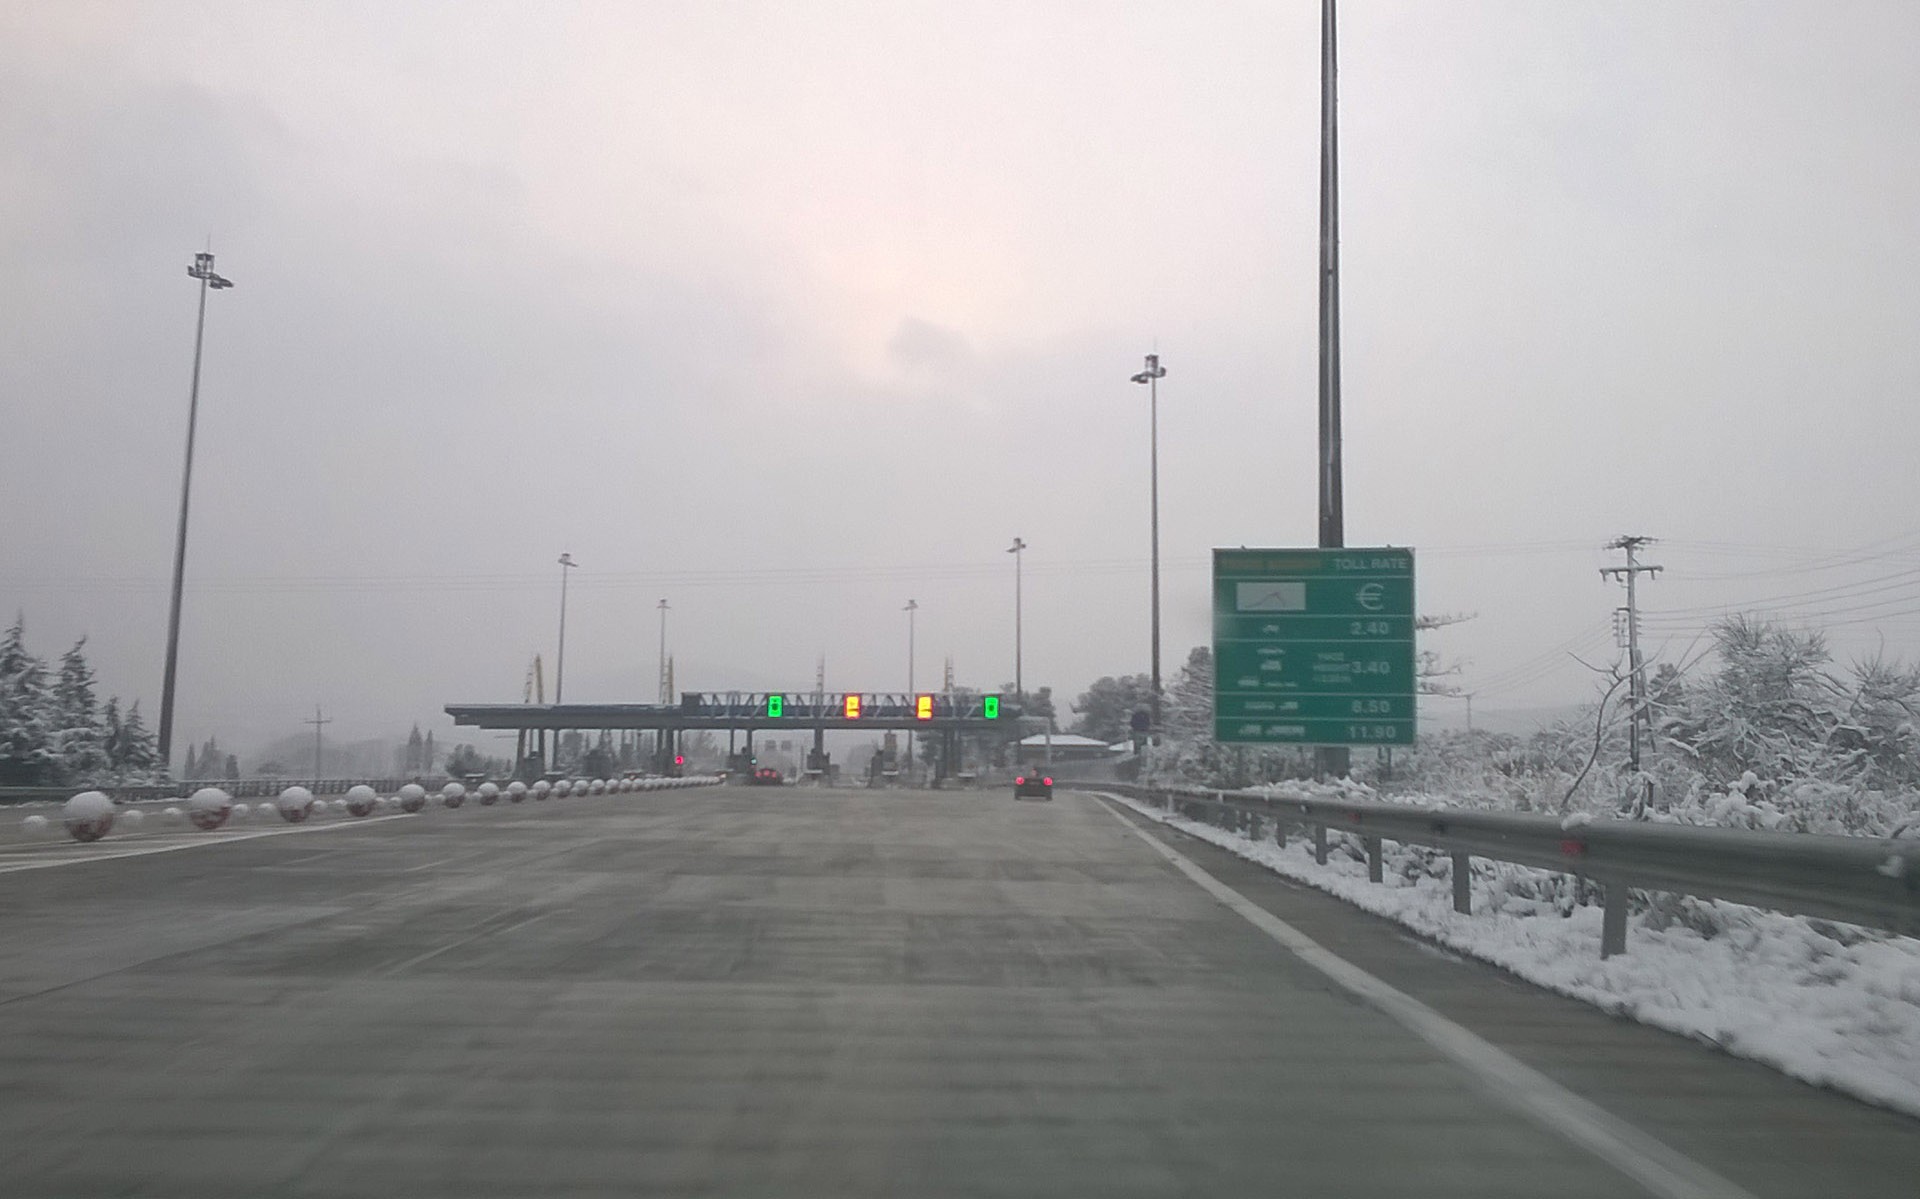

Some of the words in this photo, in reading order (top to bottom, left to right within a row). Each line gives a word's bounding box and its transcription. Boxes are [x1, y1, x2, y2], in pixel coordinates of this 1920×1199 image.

[1334, 558, 1369, 569] TOLL
[1371, 558, 1408, 569] RATE
[1356, 583, 1385, 611] €
[1350, 621, 1389, 635] 2.40
[1351, 661, 1391, 675] 3.40
[1348, 725, 1396, 739] 11.90
